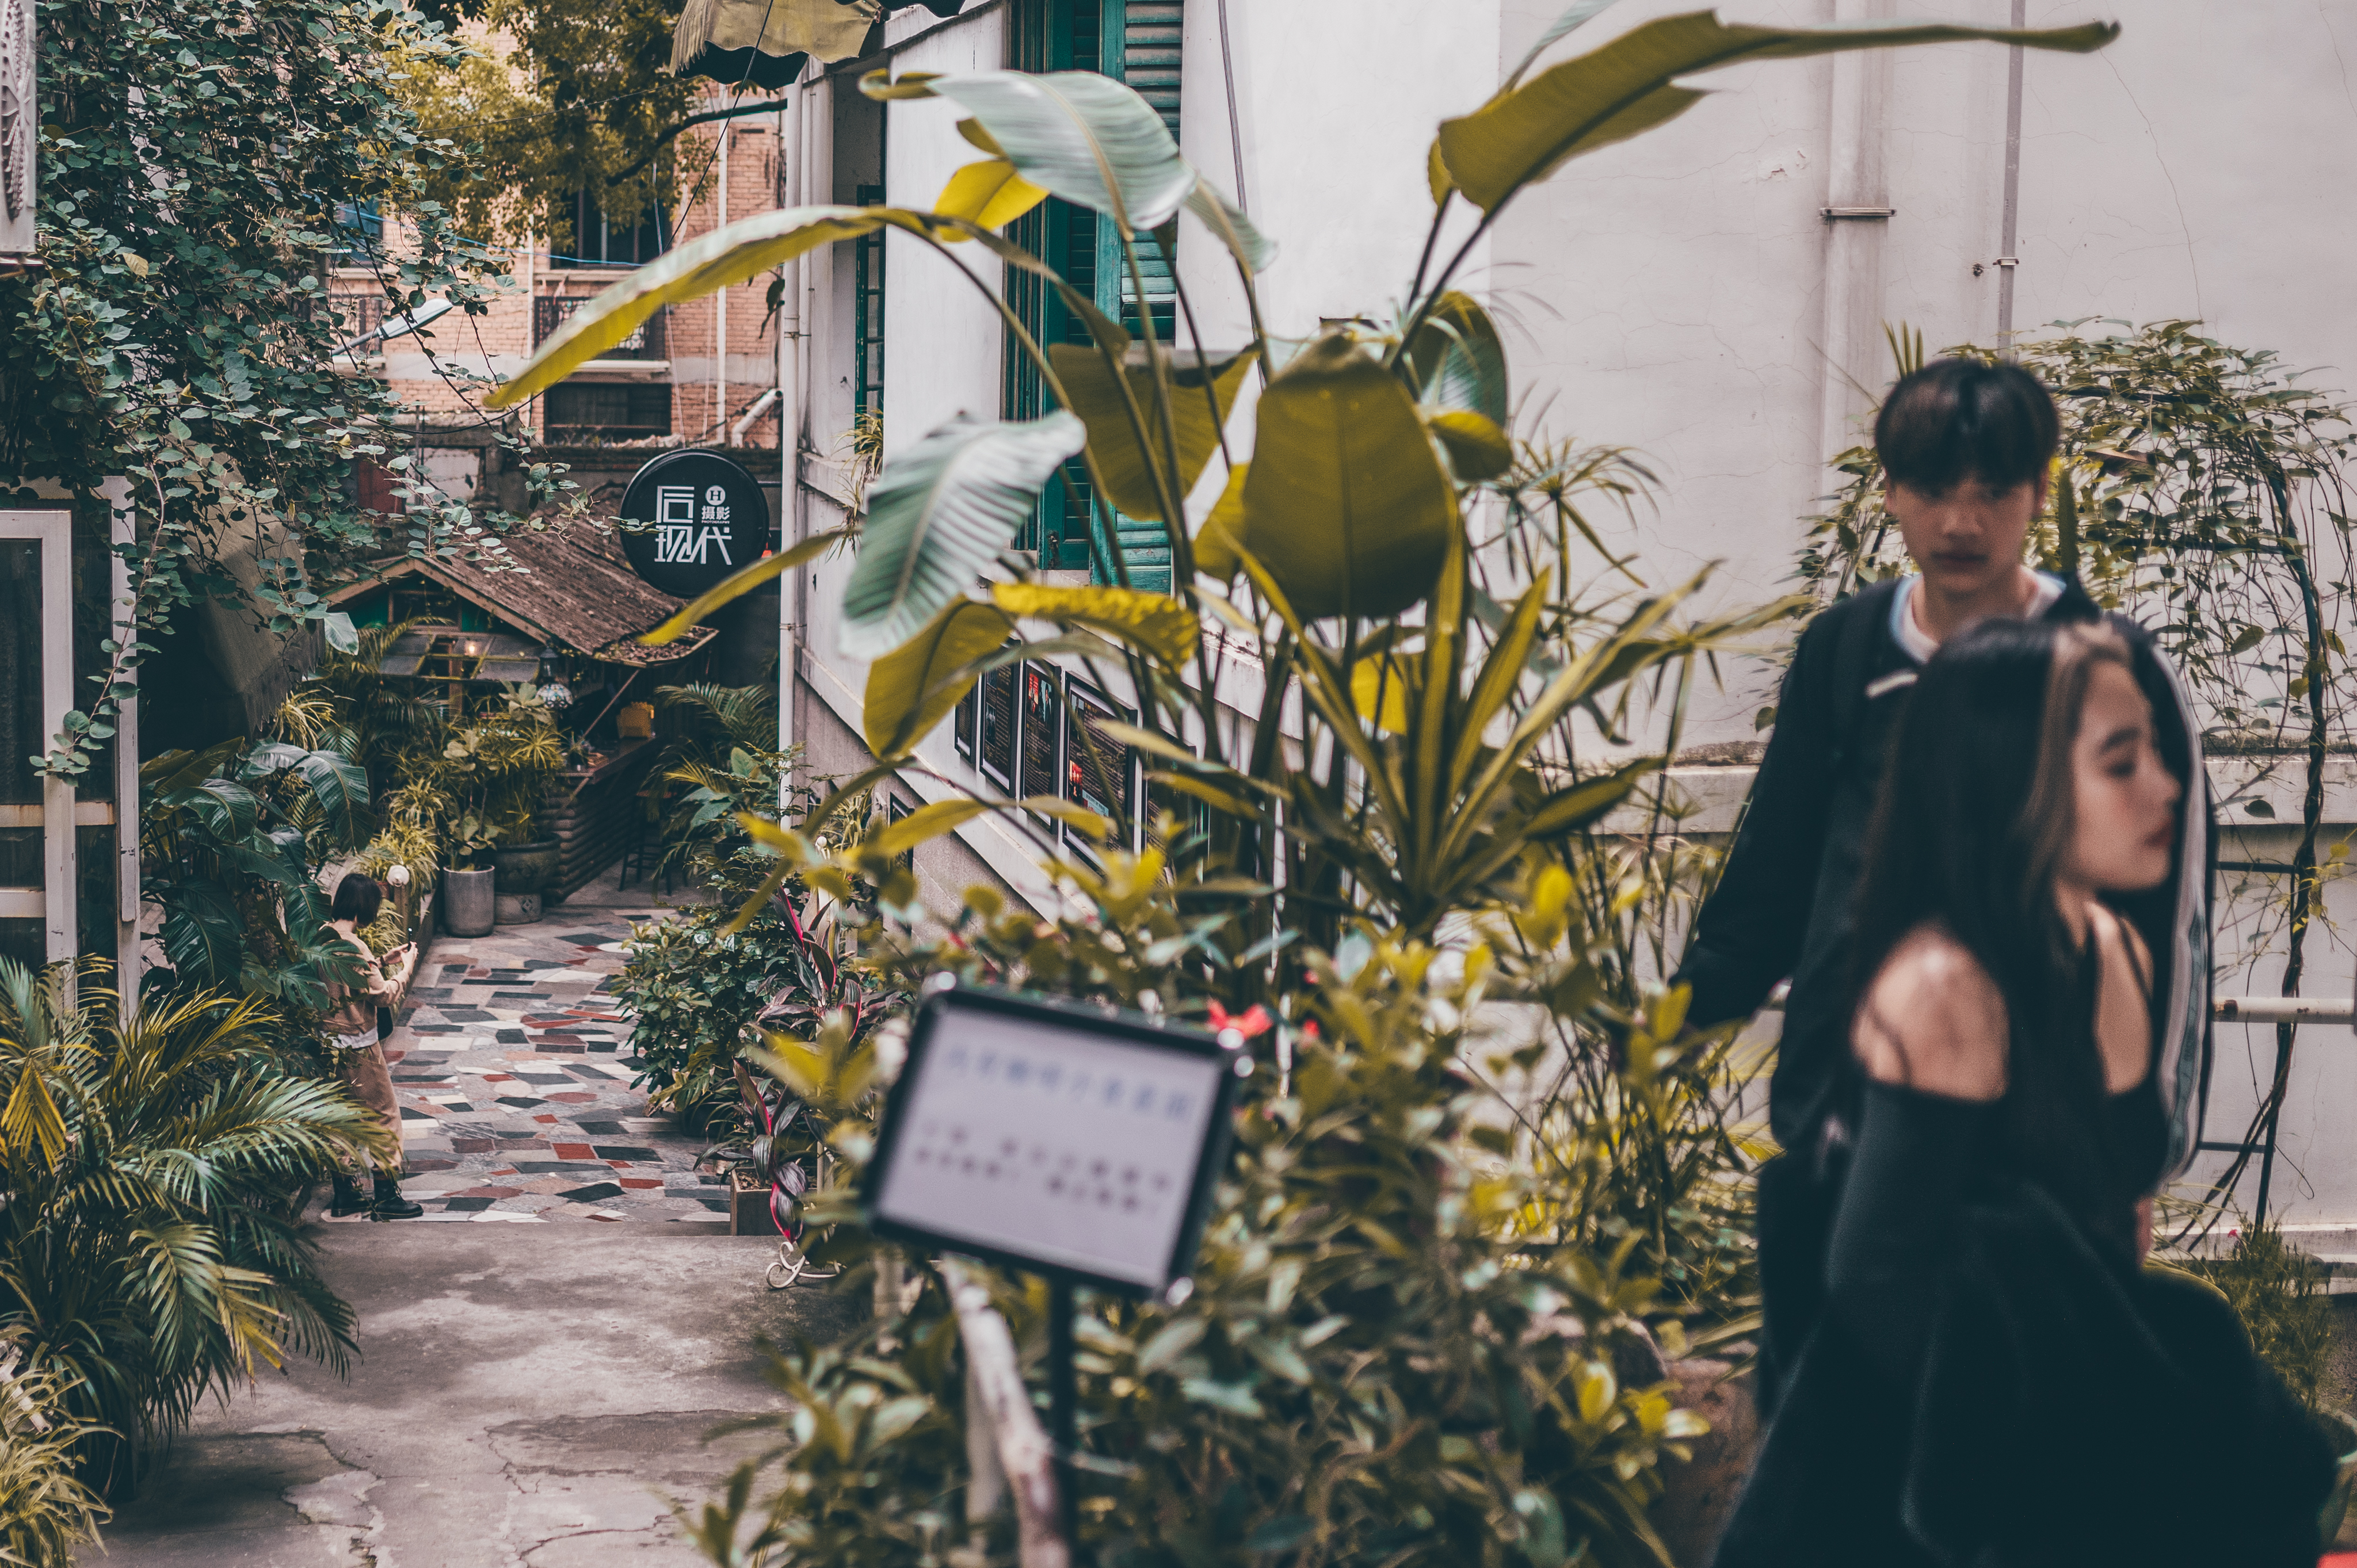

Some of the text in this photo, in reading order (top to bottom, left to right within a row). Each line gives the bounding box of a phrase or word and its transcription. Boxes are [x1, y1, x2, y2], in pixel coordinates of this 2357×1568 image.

[656, 486, 695, 523] 后
[701, 505, 730, 520] 摄影
[654, 525, 732, 565] 现代
